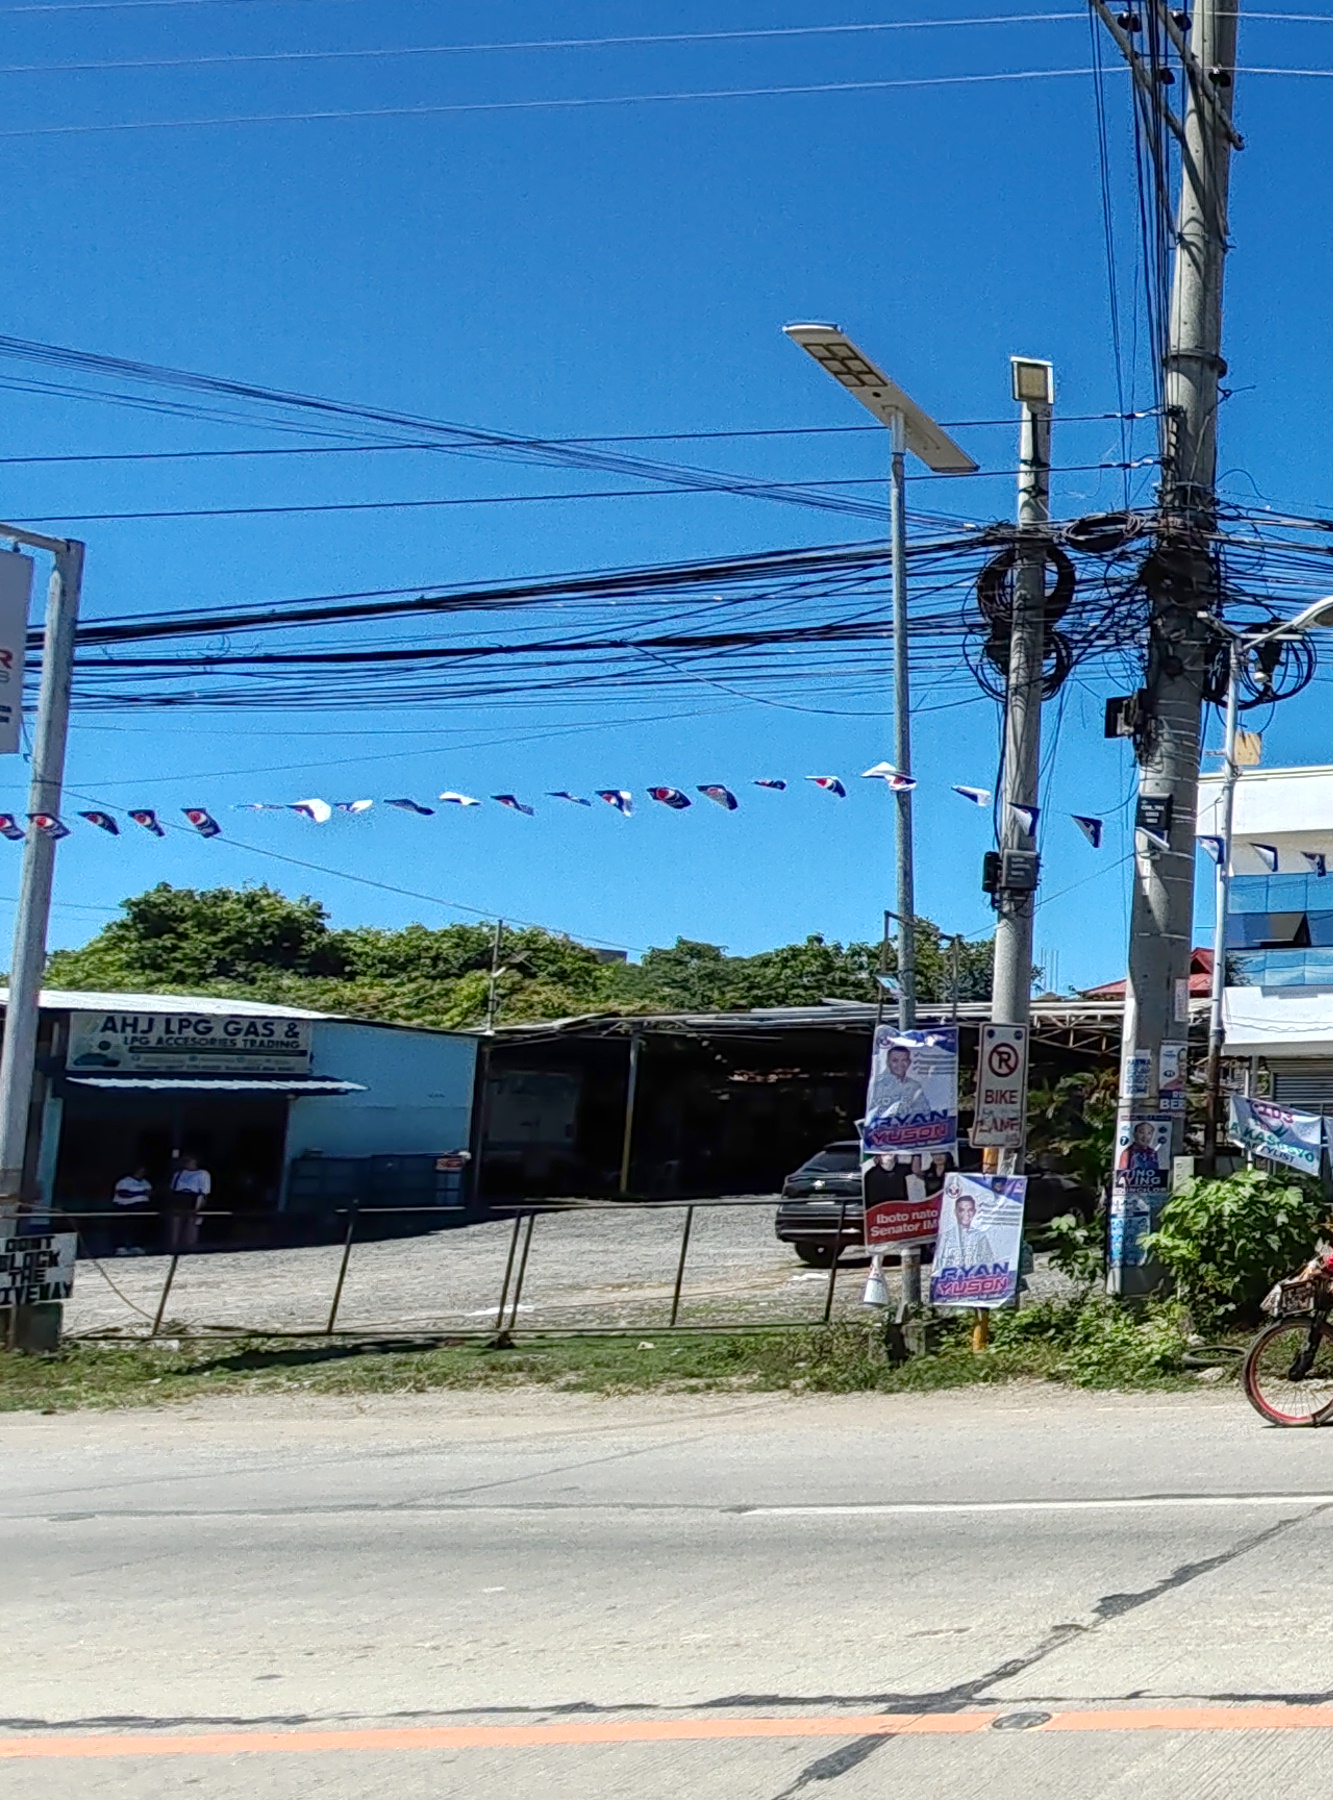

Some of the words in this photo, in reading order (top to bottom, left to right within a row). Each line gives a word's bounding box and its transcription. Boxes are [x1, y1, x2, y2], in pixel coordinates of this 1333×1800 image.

[101, 1016, 155, 1035] AHJ
[164, 1018, 214, 1036] LPG
[223, 1019, 275, 1038] GAS
[285, 1021, 300, 1039] &
[124, 1035, 150, 1046] LPG
[242, 1038, 301, 1050] TRADING
[984, 1089, 1019, 1105] BIKE
[873, 1122, 949, 1147] YUSON
[876, 1212, 909, 1224] Iboto
[911, 1209, 939, 1220] nato
[870, 1222, 922, 1238] Senator
[941, 1262, 1010, 1280] RYAN
[939, 1278, 1009, 1298] YUSON
